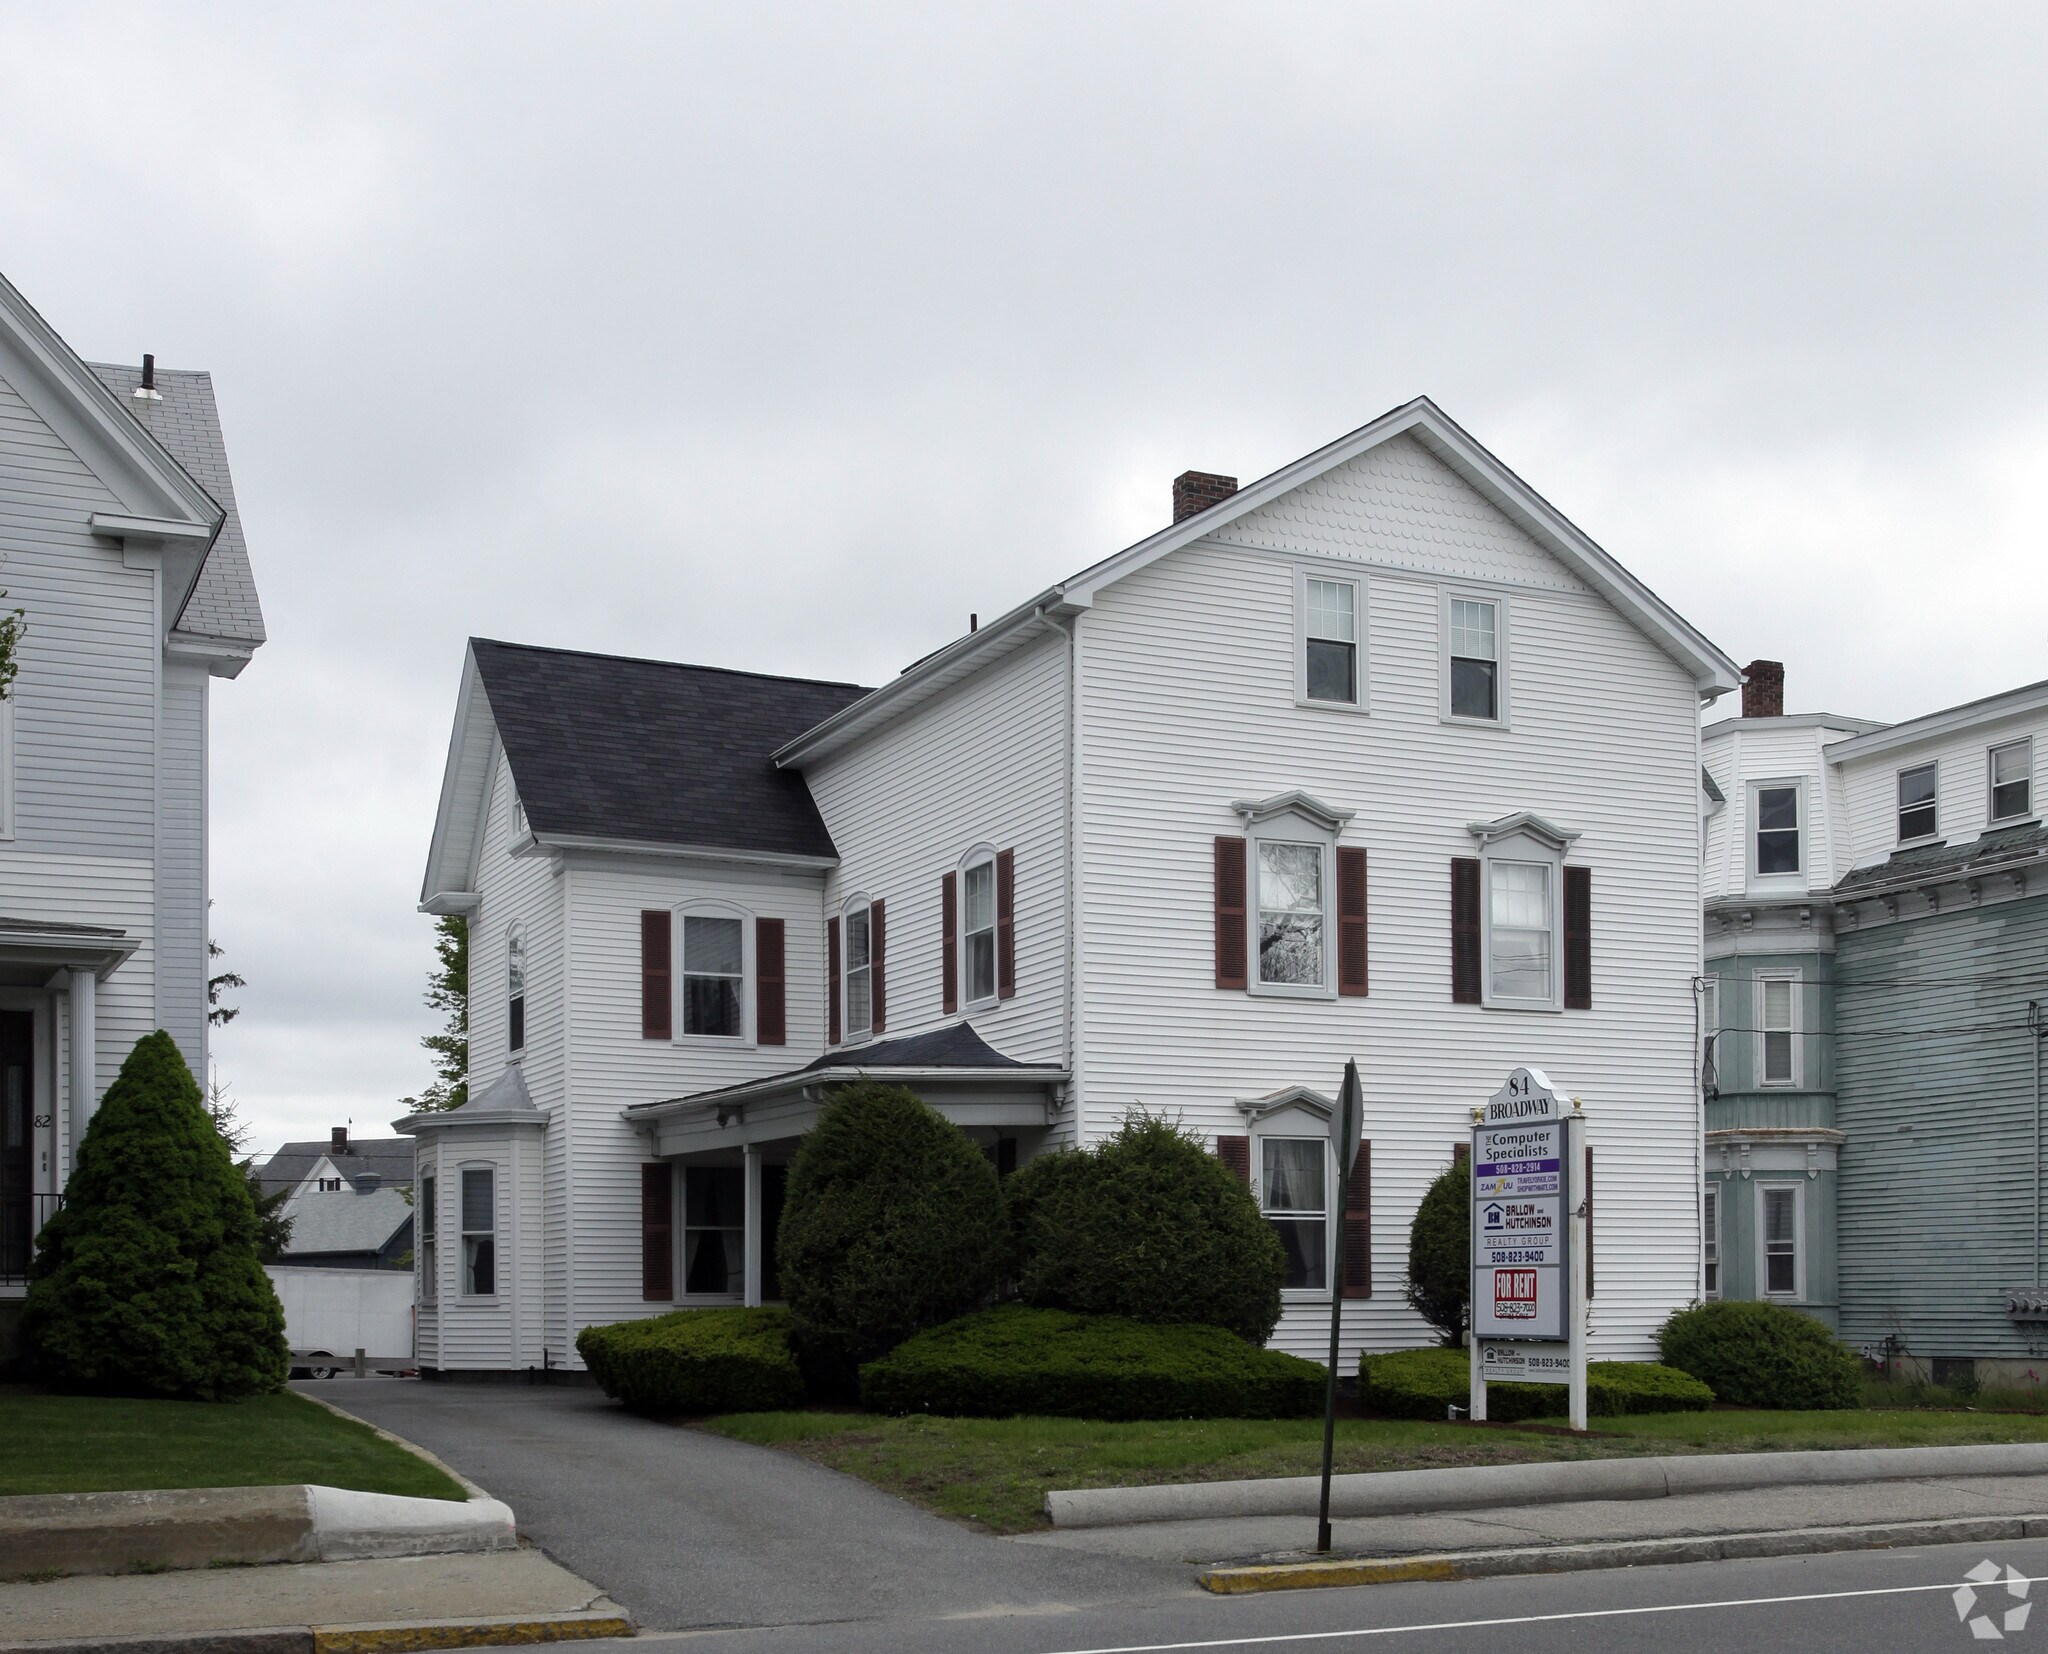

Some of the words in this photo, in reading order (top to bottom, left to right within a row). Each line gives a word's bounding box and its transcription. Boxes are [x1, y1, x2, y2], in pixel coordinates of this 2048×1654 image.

[1509, 1076, 1529, 1097] 84
[1490, 1098, 1551, 1120] BROADWAY
[34, 1115, 51, 1128] 82
[1492, 1132, 1551, 1146] Computer
[1486, 1145, 1549, 1162] Specialists
[1496, 1162, 1541, 1175] 508-828-2914
[1506, 1204, 1535, 1216] BALLOW
[1488, 1211, 1500, 1224] BH
[1506, 1216, 1551, 1229] HUTCHINSON
[1487, 1237, 1517, 1246] REALTY
[1522, 1236, 1549, 1245] GROUP
[1491, 1250, 1544, 1263] 508-823-9400
[1496, 1273, 1511, 1298] FOR
[1513, 1273, 1535, 1298] RENT
[1528, 1358, 1570, 1368] 508-823-9400
